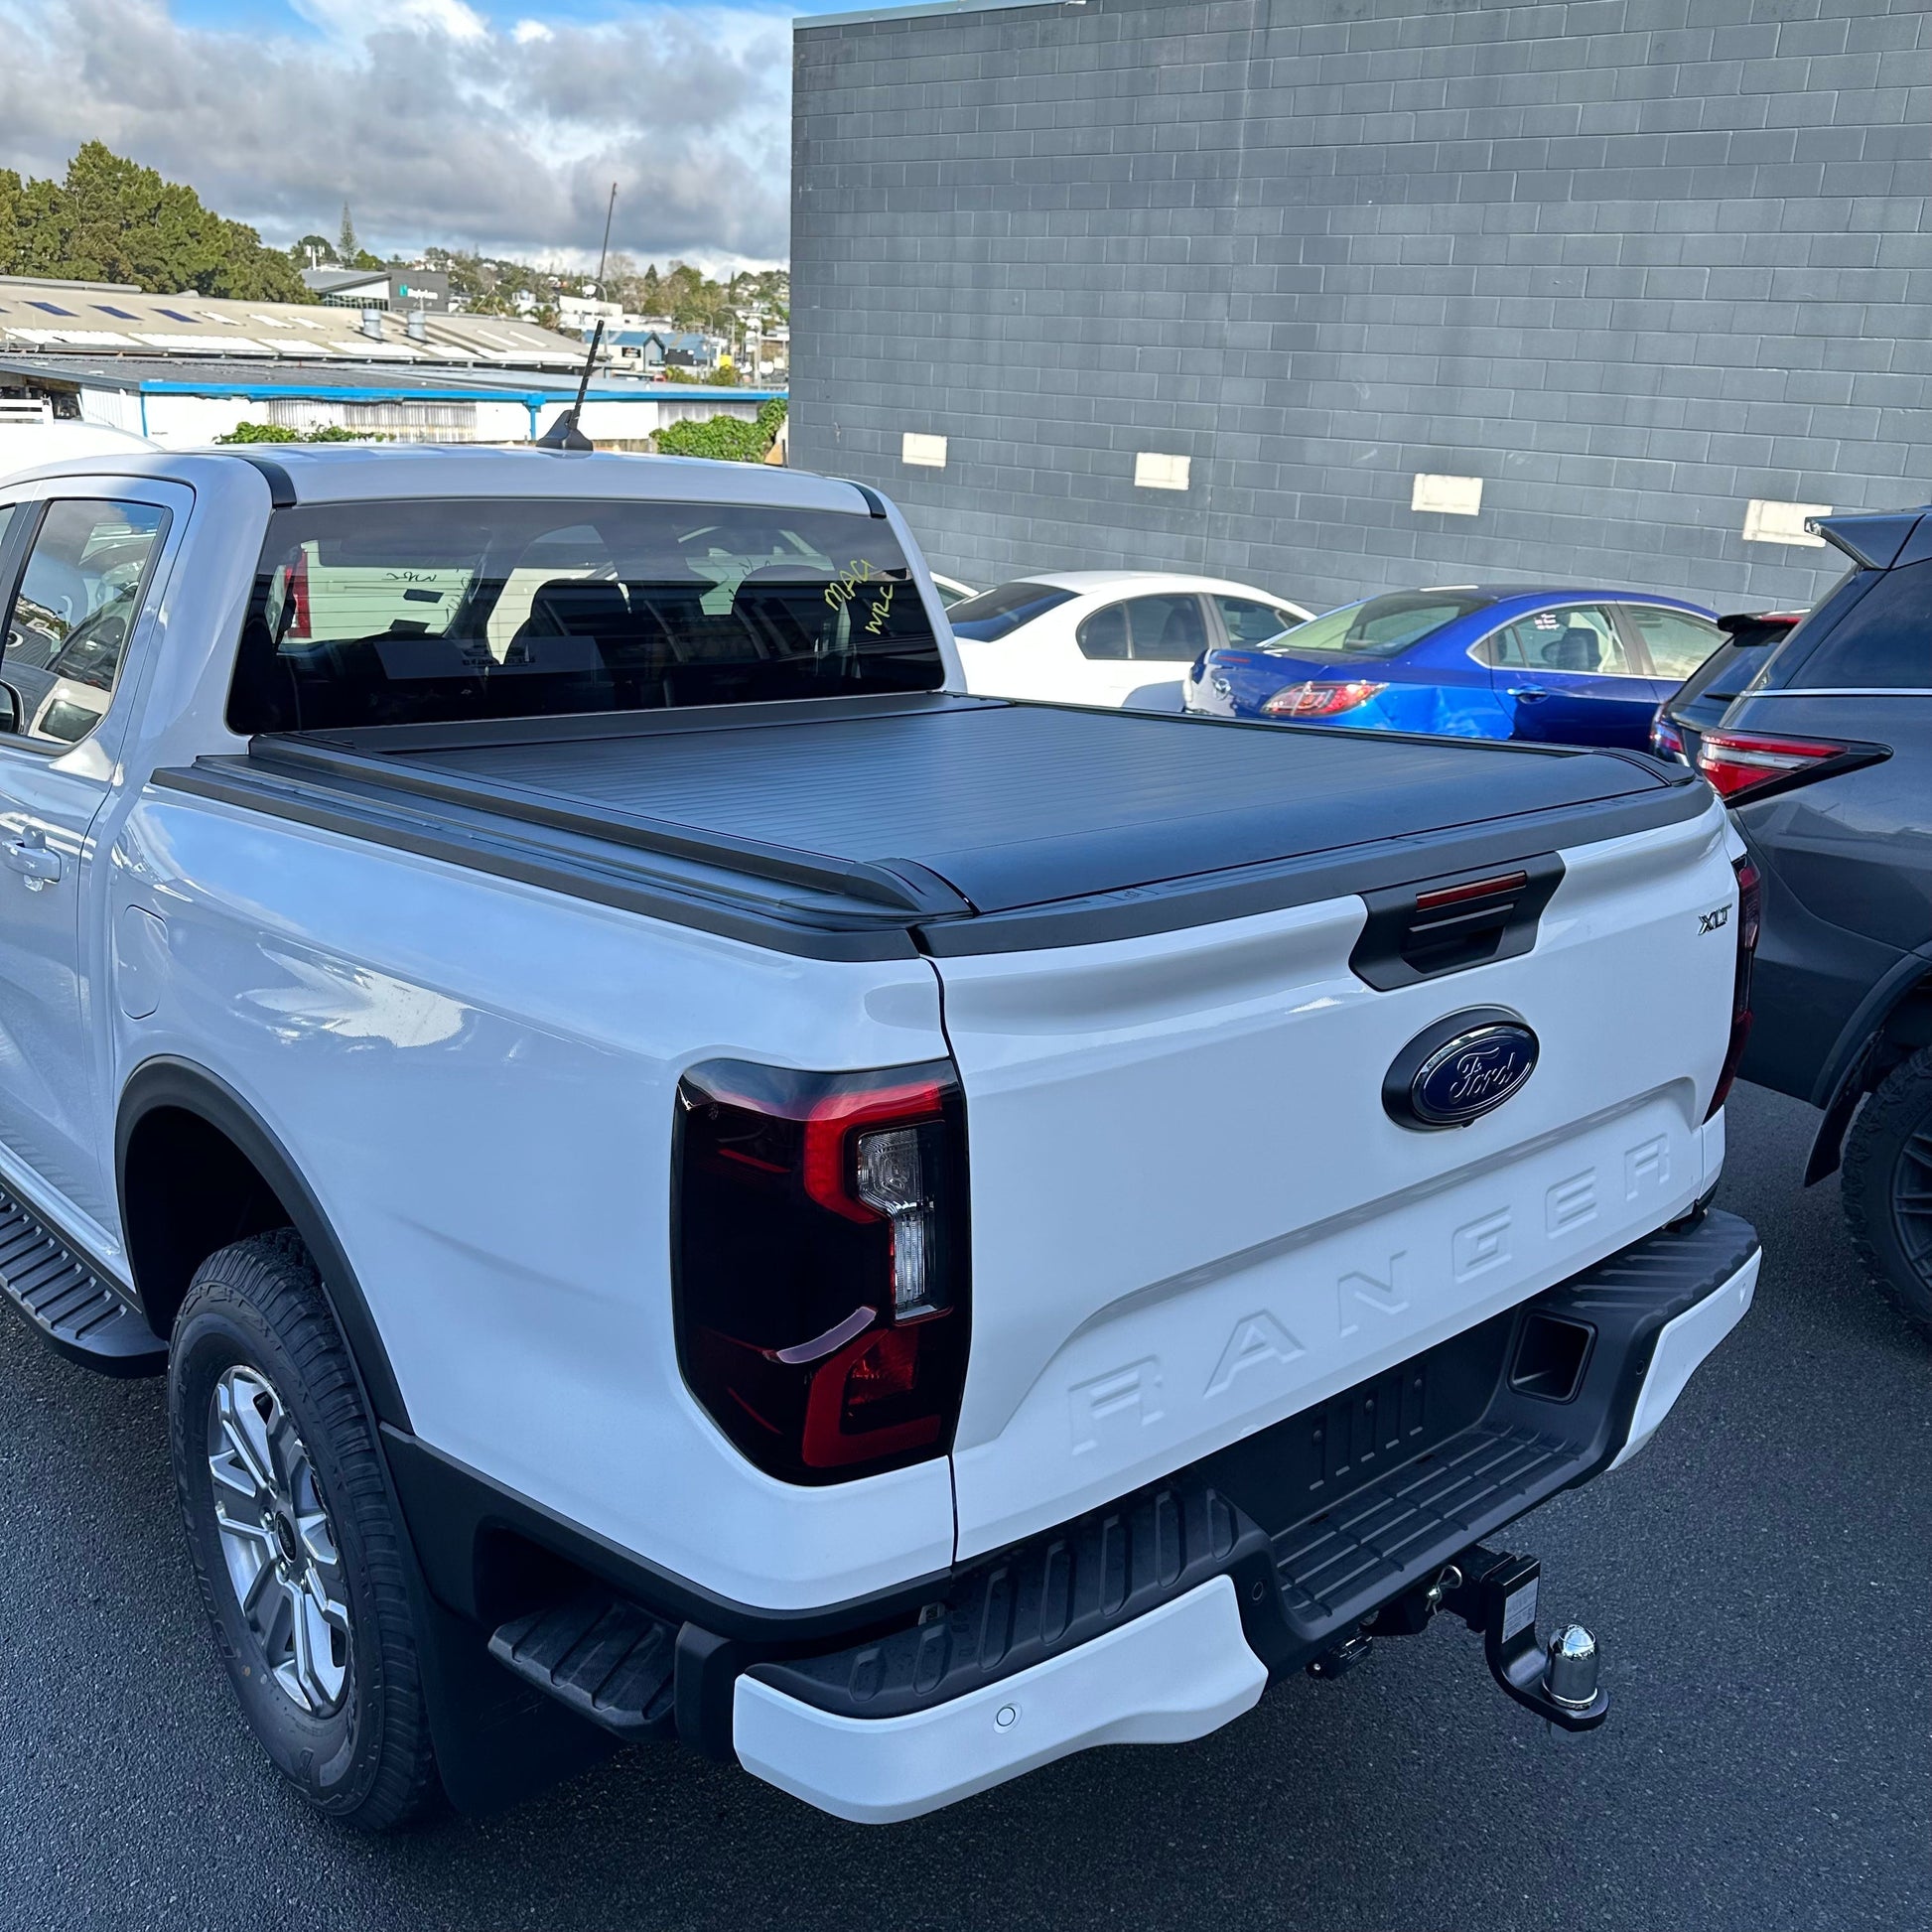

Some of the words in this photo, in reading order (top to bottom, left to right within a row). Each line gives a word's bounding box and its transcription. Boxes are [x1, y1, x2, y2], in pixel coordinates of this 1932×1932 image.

[1698, 902, 1733, 936] XLT
[1448, 1046, 1516, 1105] Ford
[1067, 1132, 1671, 1455] RANGER
